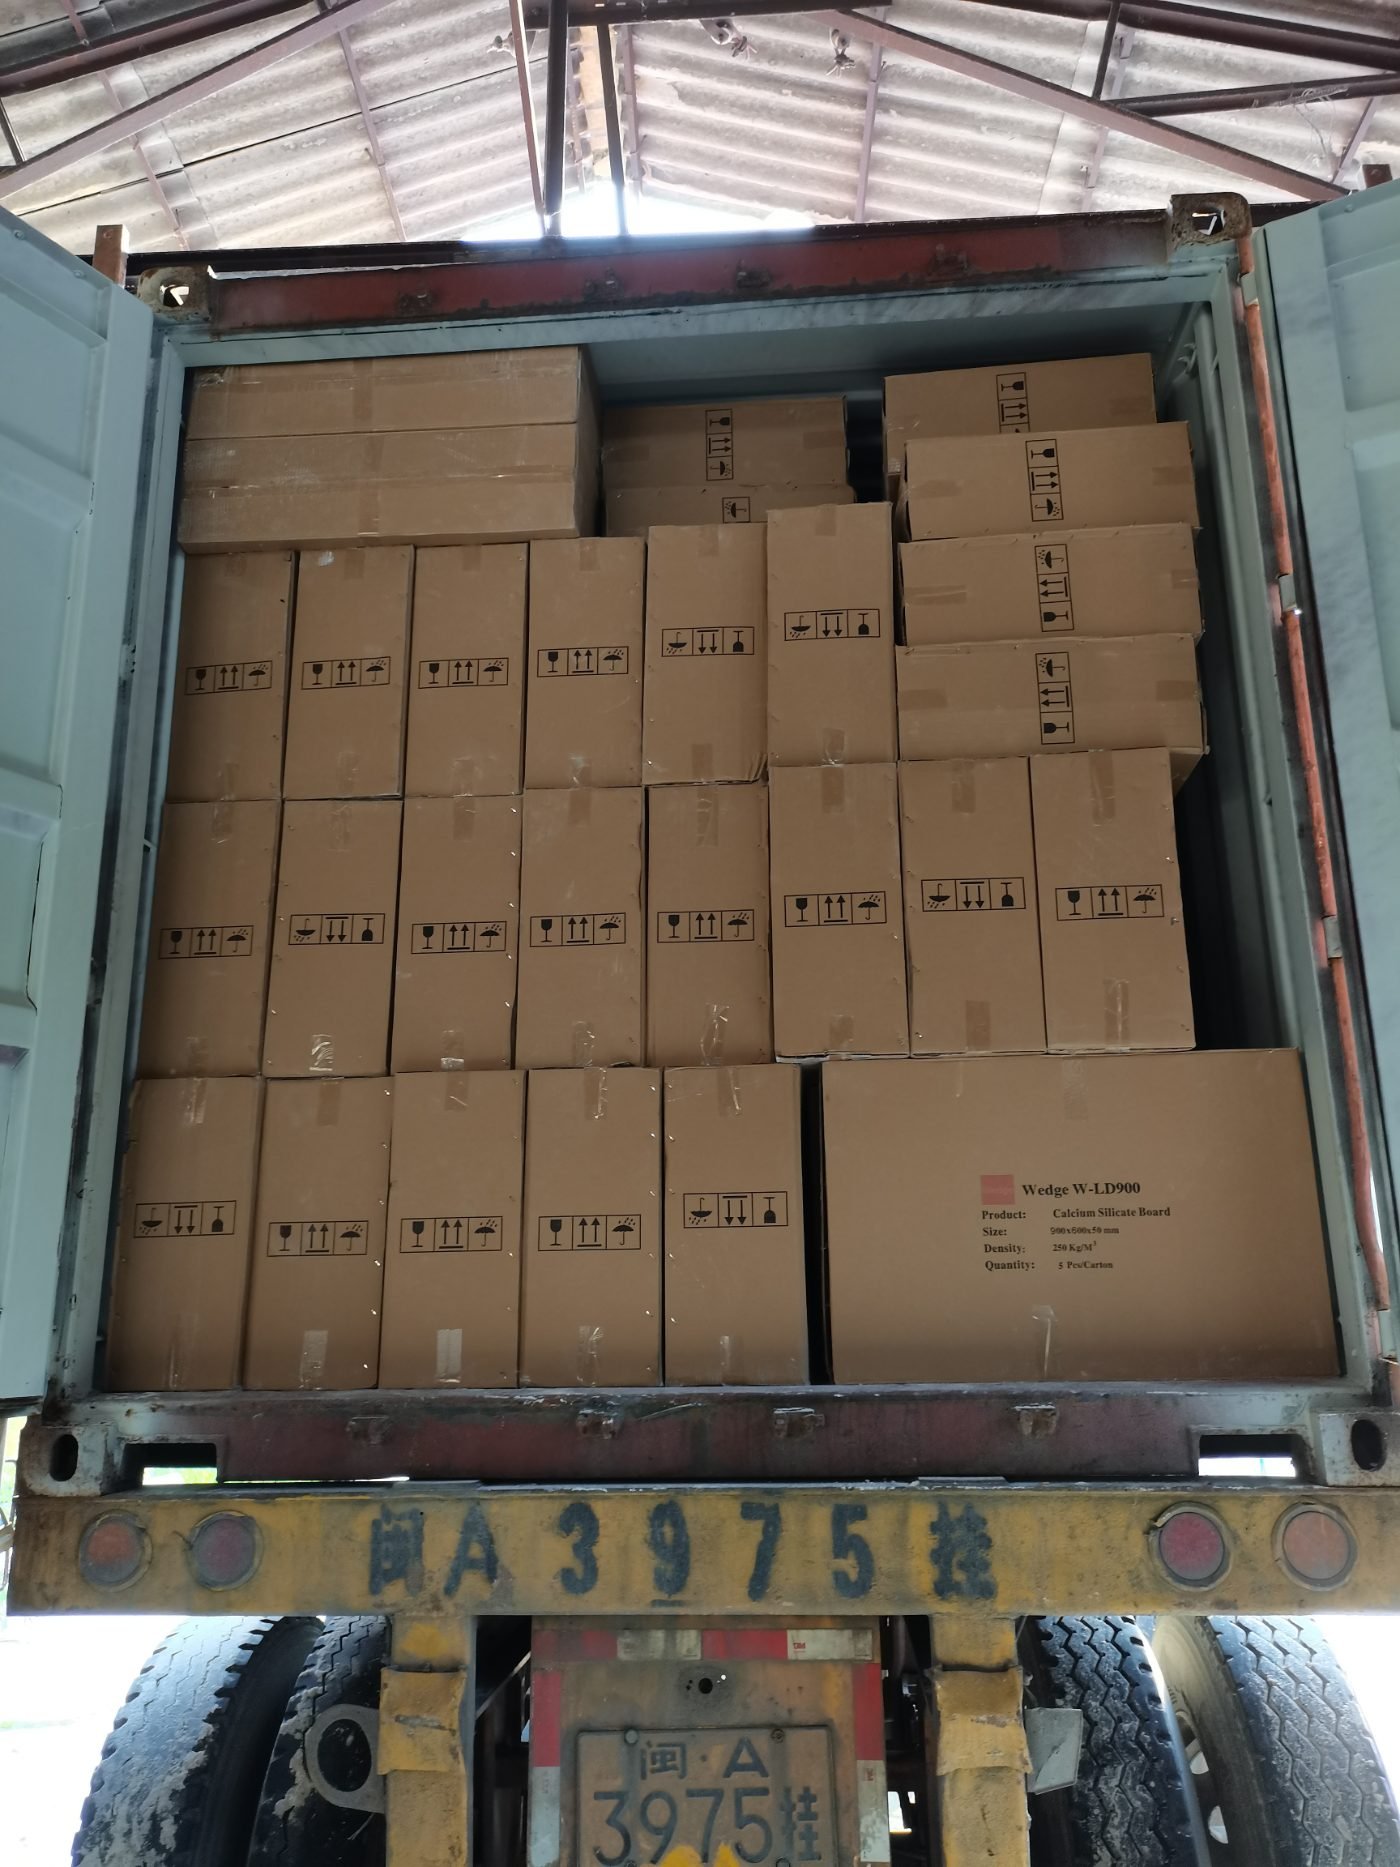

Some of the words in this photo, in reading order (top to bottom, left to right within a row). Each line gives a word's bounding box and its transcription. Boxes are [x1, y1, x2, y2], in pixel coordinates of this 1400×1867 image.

[1022, 1184, 1069, 1198] Wedge
[1072, 1182, 1141, 1195] W-LD900
[981, 1210, 1027, 1220] Product:
[1053, 1208, 1096, 1218] Calcium
[1098, 1207, 1136, 1217] Silicate
[1139, 1206, 1171, 1217] Board
[982, 1227, 1007, 1236] Size:
[984, 1243, 1026, 1254] Density:
[1052, 1243, 1067, 1252] 250
[985, 1260, 1036, 1271] Quantity:
[1058, 1262, 1064, 1270] 5
[1067, 1260, 1114, 1269] Pcs/Carton
